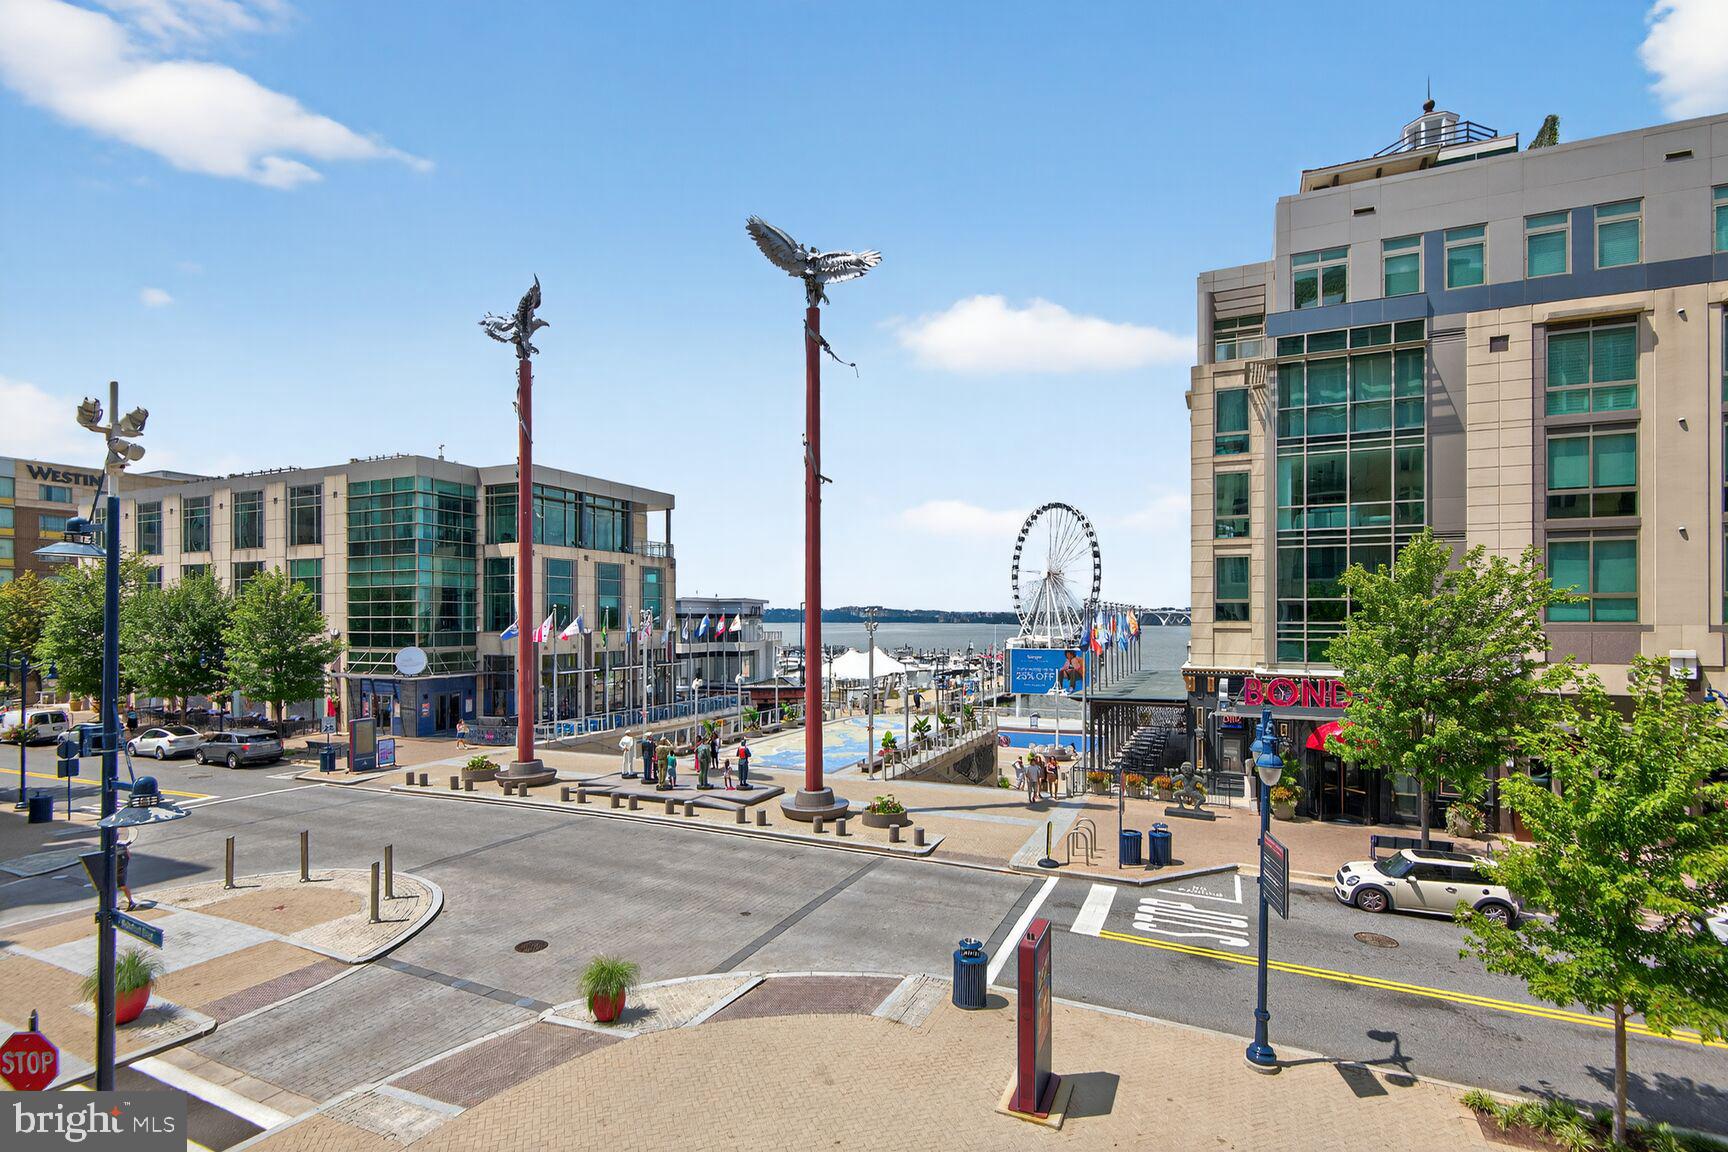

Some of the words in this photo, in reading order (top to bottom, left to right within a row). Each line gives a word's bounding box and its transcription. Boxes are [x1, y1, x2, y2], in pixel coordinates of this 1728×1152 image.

[26, 464, 101, 487] WESTIN
[1035, 672, 1055, 681] OFF
[1244, 677, 1353, 709] BOND
[2, 1051, 54, 1074] STOP
